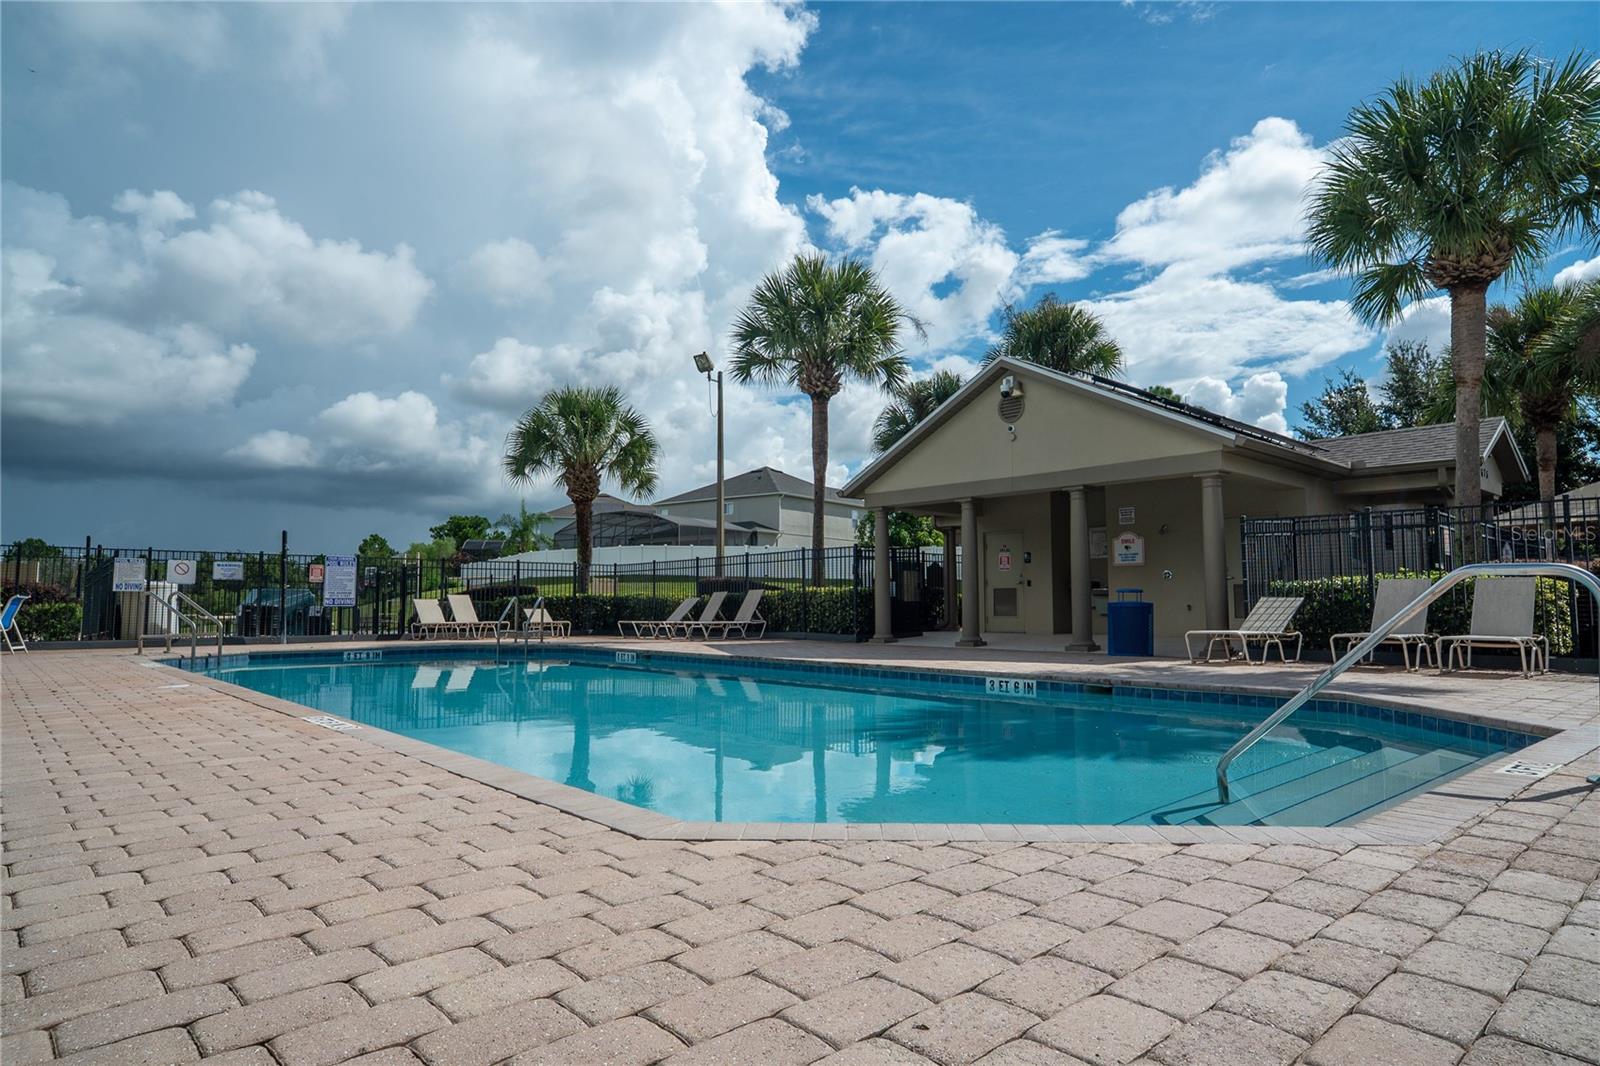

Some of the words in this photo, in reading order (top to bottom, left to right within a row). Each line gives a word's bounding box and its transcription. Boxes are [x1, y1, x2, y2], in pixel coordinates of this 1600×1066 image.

[325, 598, 334, 606] NO
[335, 598, 354, 606] DIVING
[1023, 681, 1034, 693] IN
